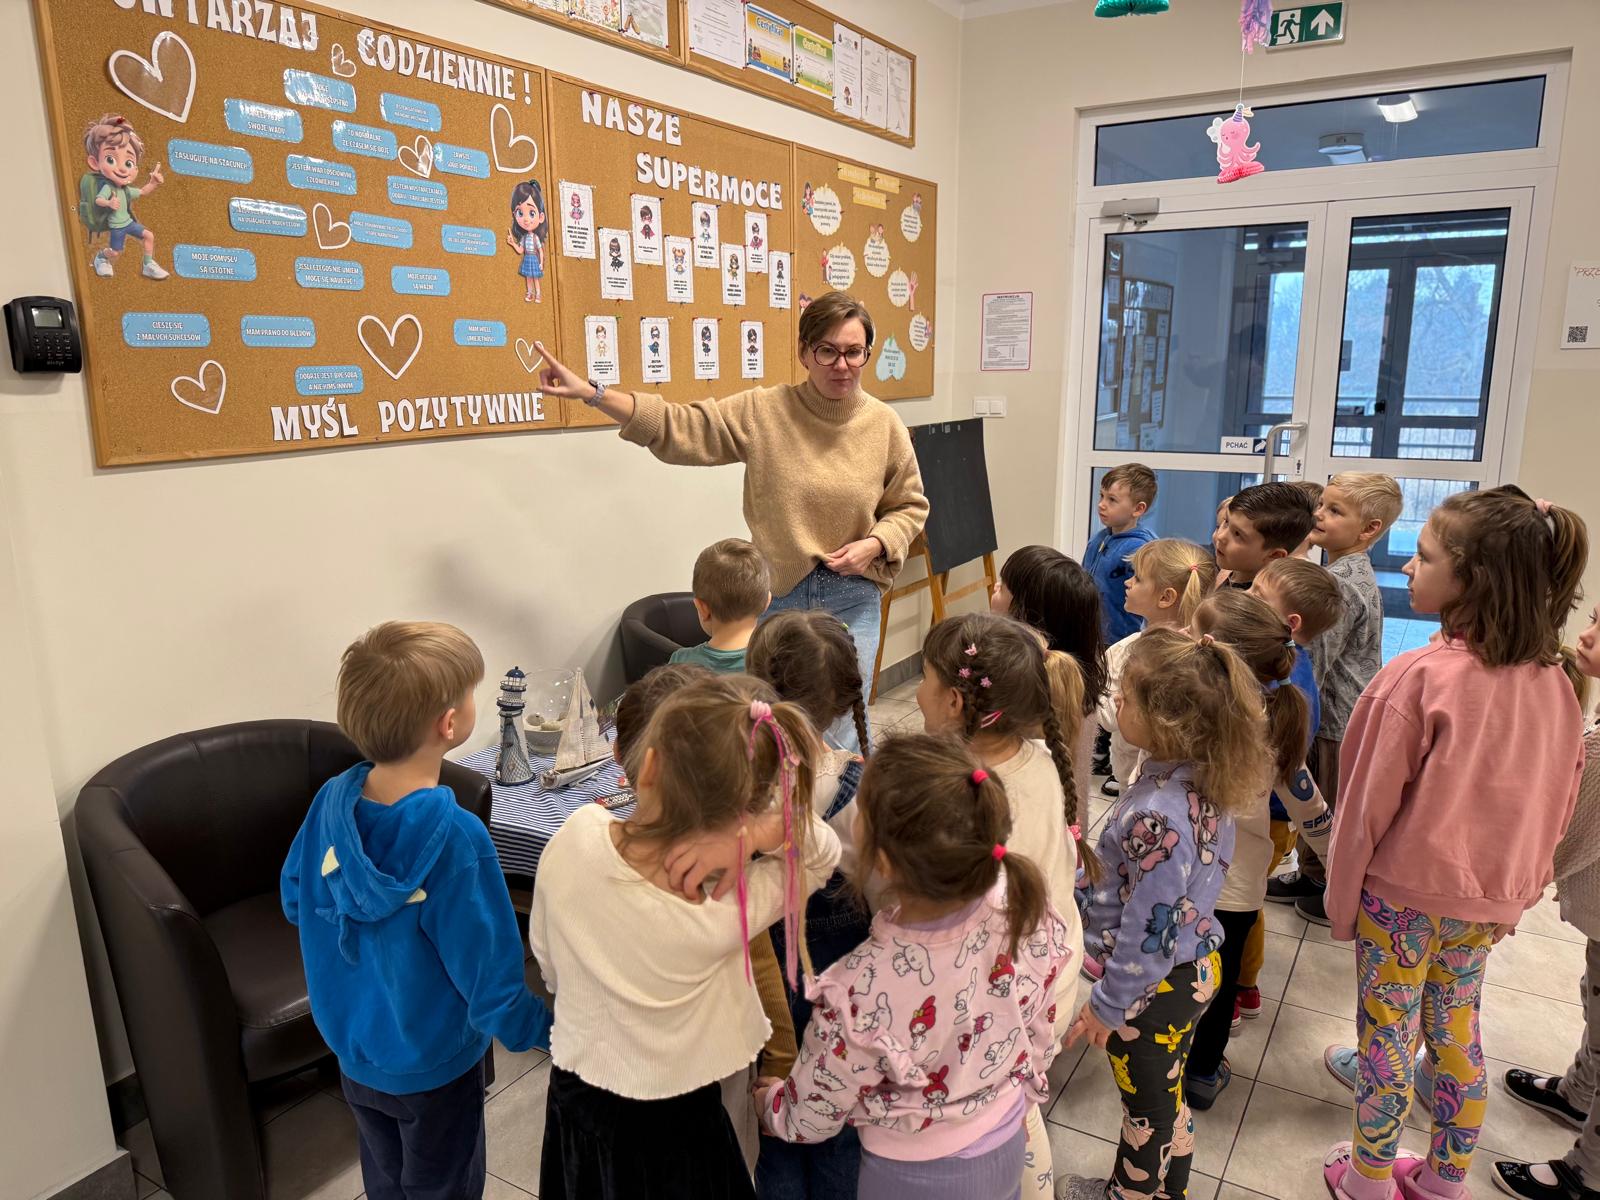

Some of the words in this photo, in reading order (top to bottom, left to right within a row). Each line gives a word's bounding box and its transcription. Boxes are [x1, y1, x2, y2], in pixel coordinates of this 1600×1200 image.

[356, 28, 516, 101] CODZIENNIE
[523, 71, 532, 105] !
[581, 90, 682, 146] NASZE
[636, 151, 783, 210] SUPERMOCE
[191, 252, 209, 261] MOJE
[270, 397, 359, 441] MYŚL
[377, 392, 545, 433] POZYTYWNIE
[1225, 440, 1248, 449] PCHAĆ
